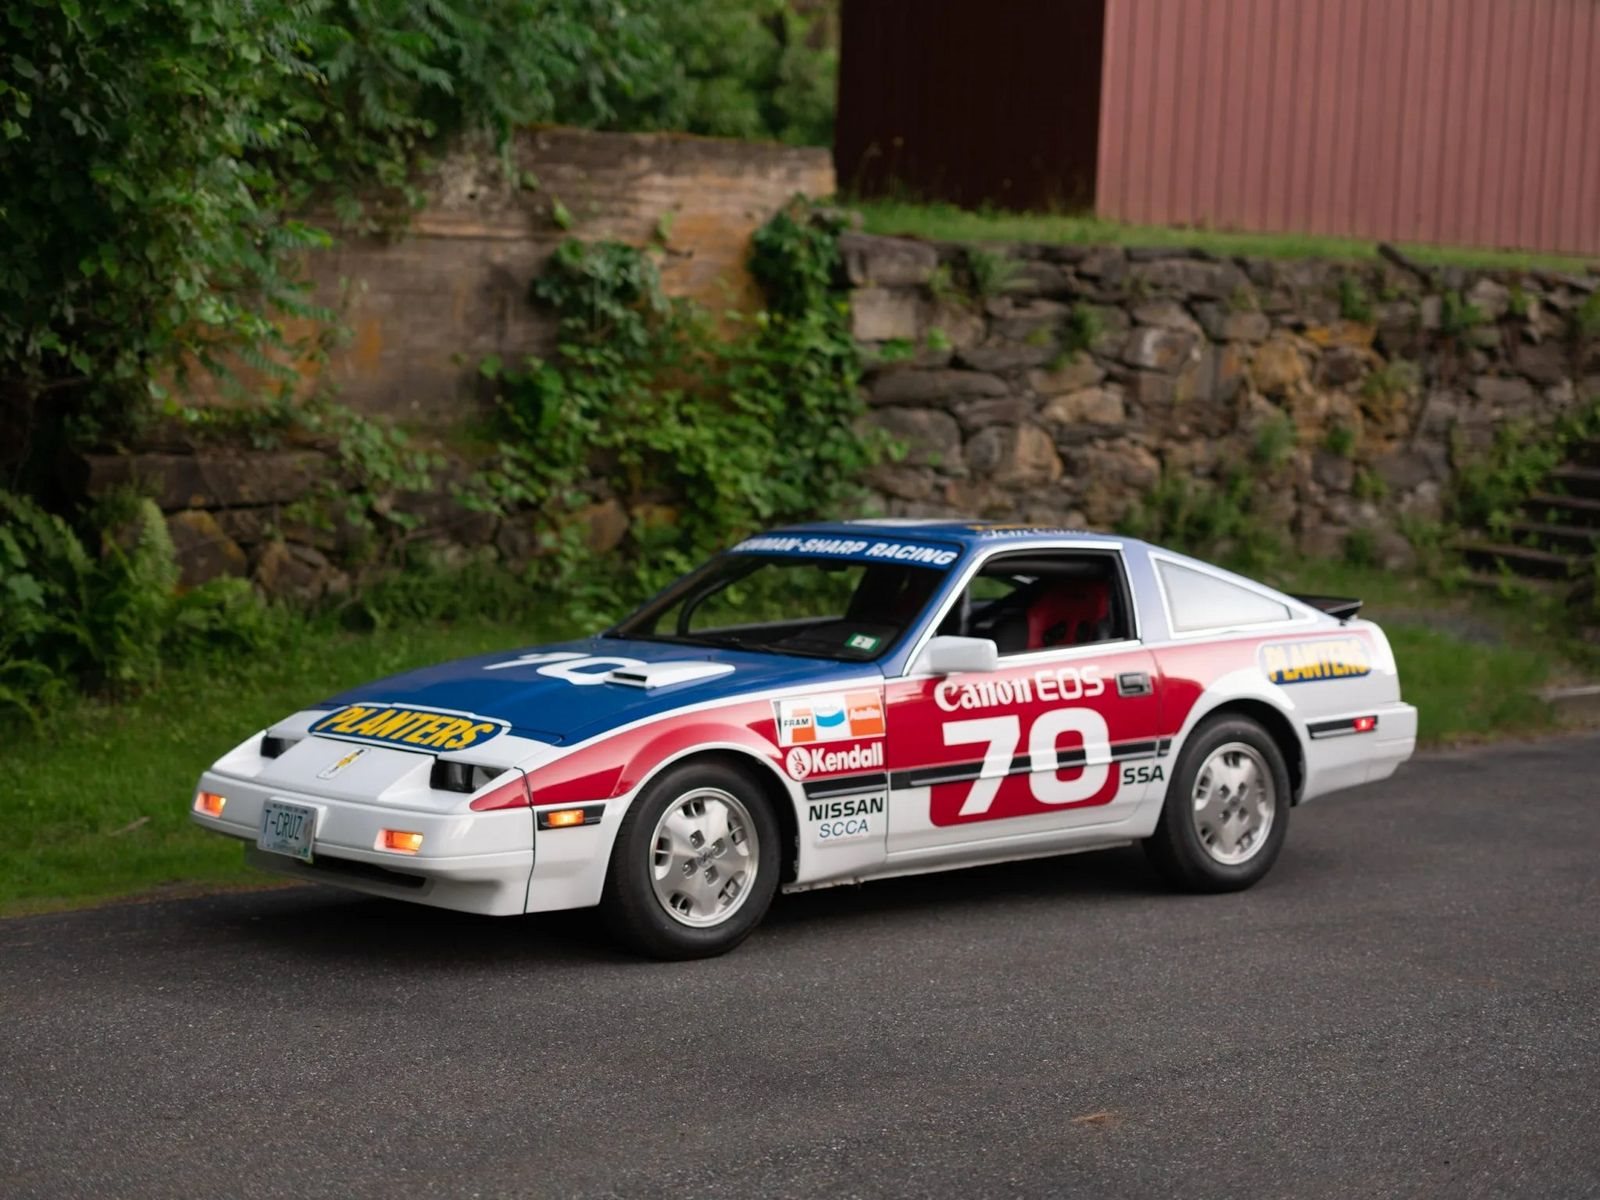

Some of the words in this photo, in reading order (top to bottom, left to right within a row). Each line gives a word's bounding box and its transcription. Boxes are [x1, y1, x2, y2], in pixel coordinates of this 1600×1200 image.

[865, 542, 958, 566] RACING
[934, 675, 1032, 712] Canon
[1034, 665, 1105, 701] EOS
[315, 705, 495, 750] PLANTERS
[784, 718, 809, 727] FRAM
[811, 741, 884, 774] Kendall
[942, 707, 1114, 817] 70
[1122, 765, 1165, 786] SSA
[808, 796, 884, 822] NISSAN
[263, 808, 304, 841] T-CRUZ
[819, 818, 869, 839] SCCA
